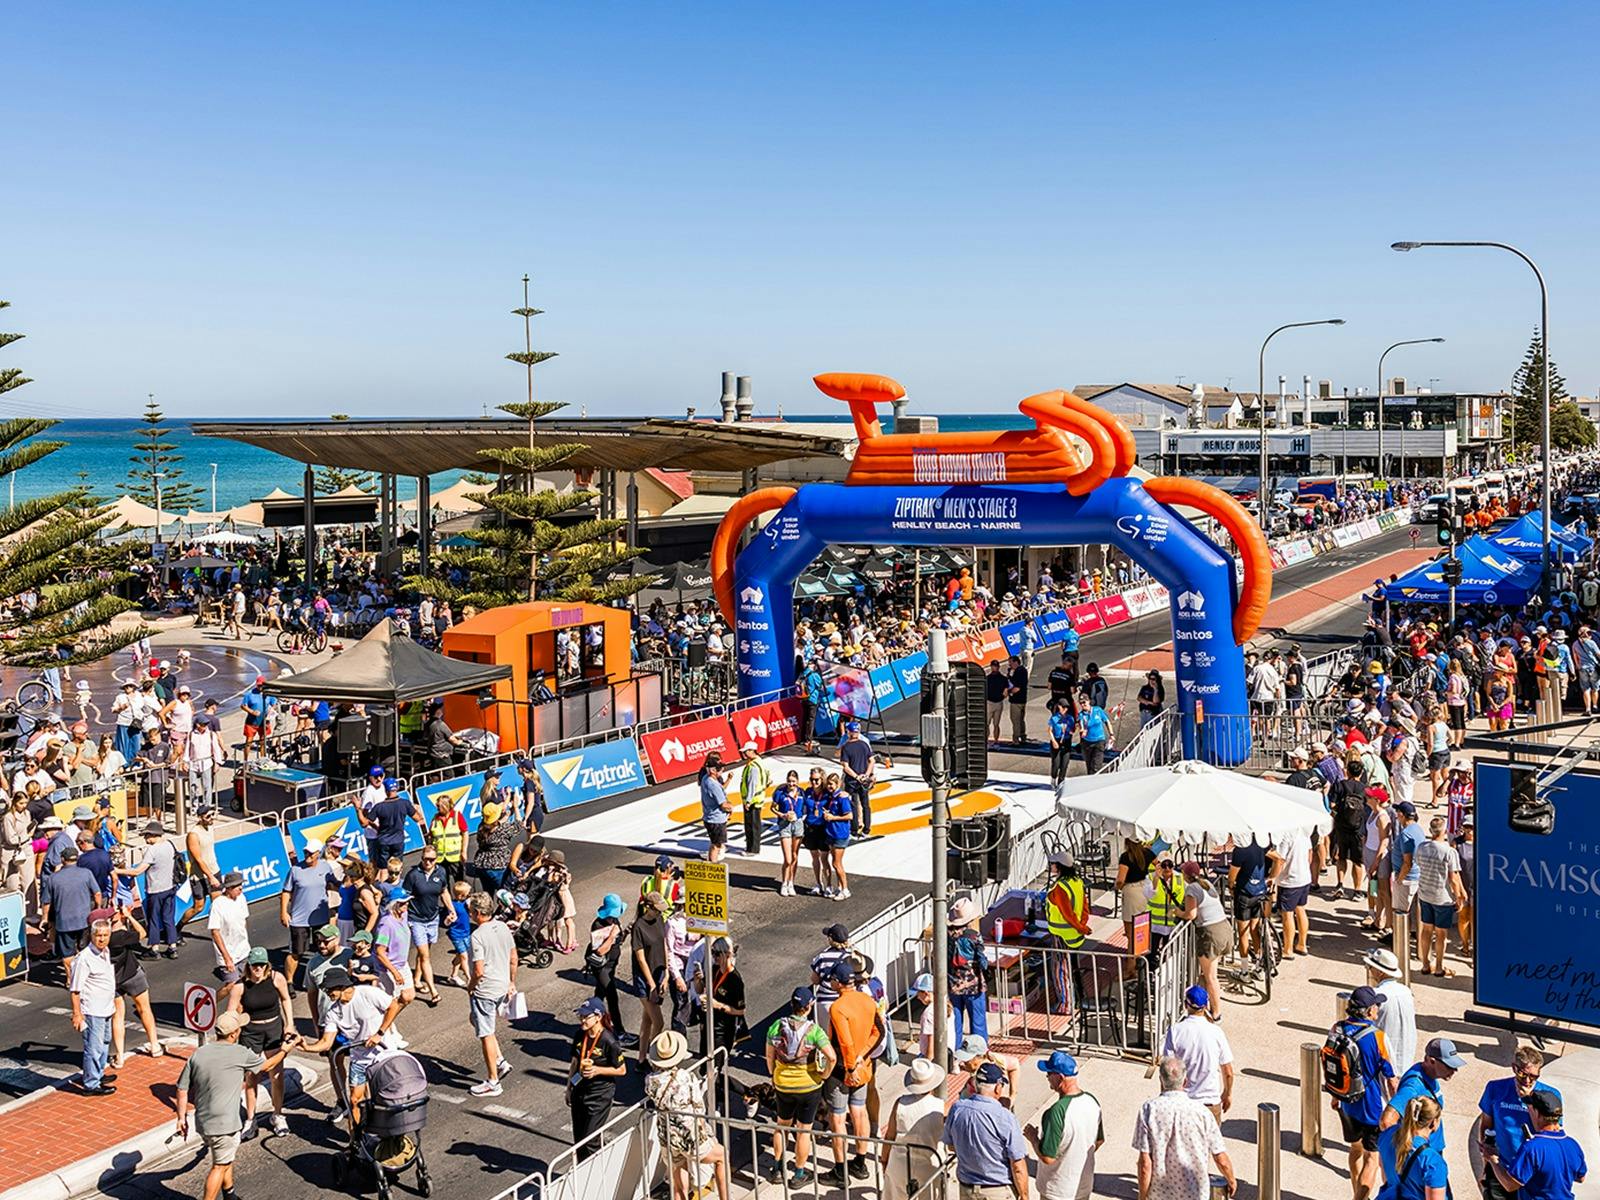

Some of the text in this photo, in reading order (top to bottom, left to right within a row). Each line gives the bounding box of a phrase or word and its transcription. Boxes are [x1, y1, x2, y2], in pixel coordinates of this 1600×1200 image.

[1203, 440, 1266, 450] HENLEY HOUS
[912, 452, 1007, 482] TOUR DOWN UNDER
[977, 497, 1008, 518] STAGE
[1009, 497, 1017, 518] 3
[892, 521, 932, 529] HENLEY
[934, 521, 971, 529] BEACH
[981, 521, 1021, 529] NAIRNE
[1150, 521, 1168, 529] tour
[1145, 527, 1167, 535] down
[1143, 534, 1167, 542] under
[1513, 538, 1543, 548] Ziptr
[1461, 577, 1498, 586] ptrak
[1414, 592, 1440, 600] Ziptrak
[737, 619, 769, 630] Santos
[1176, 630, 1213, 640] Santos
[901, 664, 924, 685] Sant
[873, 680, 894, 700] antos
[1191, 683, 1221, 694] Ziptrak
[766, 715, 798, 733] ADELAIDE
[685, 735, 725, 755] ADELAIDE
[579, 758, 637, 790] Ziptrak
[1568, 841, 1600, 855] THE
[685, 862, 725, 873] PEDESTRIAN
[686, 870, 726, 880] CROSS OVER
[689, 891, 723, 905] KEEP
[688, 903, 723, 918] CLEAR
[1505, 956, 1600, 988] meet m
[1545, 982, 1570, 1012] by
